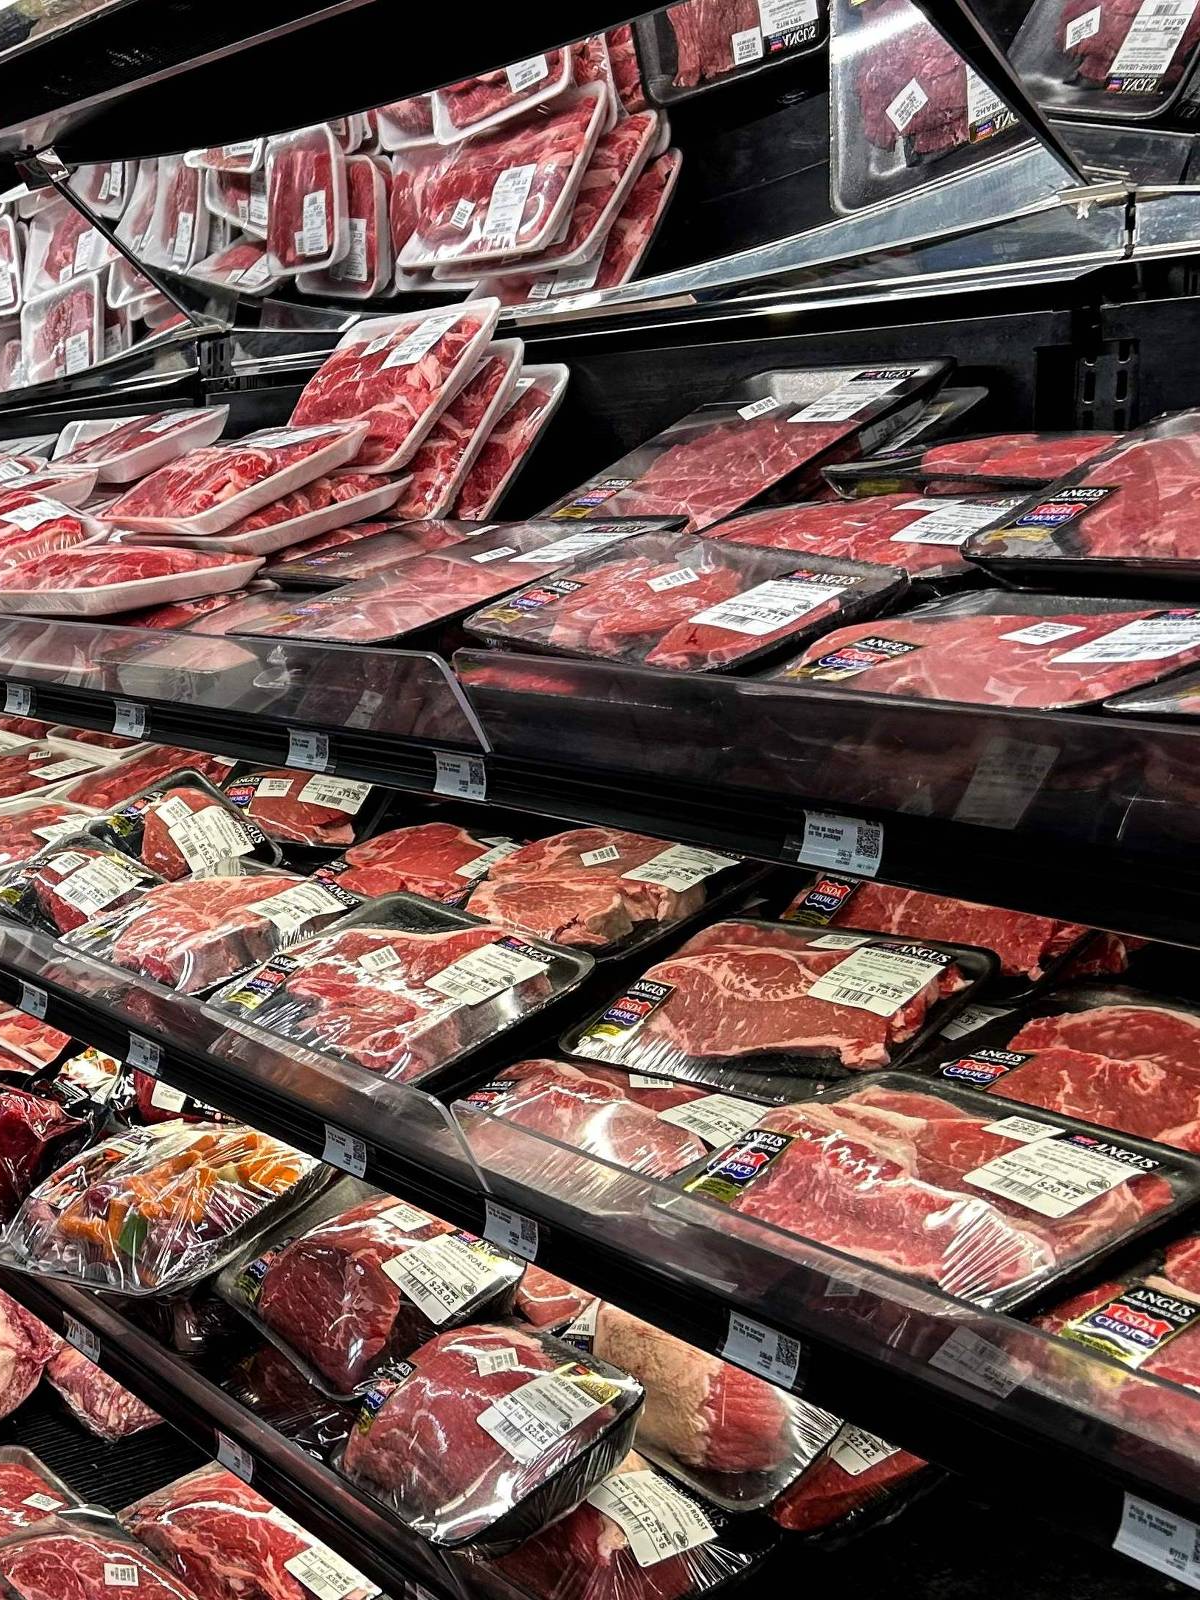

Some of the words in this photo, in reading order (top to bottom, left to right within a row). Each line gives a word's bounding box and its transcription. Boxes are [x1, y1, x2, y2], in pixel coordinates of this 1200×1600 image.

[1055, 489, 1109, 498] ANGUS
[326, 883, 360, 905] ANGUS
[810, 892, 840, 906] CHOICE
[819, 884, 842, 897] USDA
[898, 945, 951, 963] ANGUS
[868, 986, 902, 1000] $19.37
[608, 1008, 640, 1020] CHOICE
[620, 1000, 642, 1012] USDA
[976, 1049, 1026, 1062] ANGUS
[949, 1067, 994, 1079] CHOICE
[966, 1062, 996, 1074] USDA
[1092, 1142, 1160, 1170] ANGUS
[1036, 1180, 1079, 1200] $20.17
[446, 1240, 468, 1256] RUMP
[468, 1254, 492, 1274] ROAST
[428, 1280, 454, 1306] $25.02
[1129, 1290, 1196, 1317] ANGUS
[1095, 1315, 1156, 1346] CHOICE
[1114, 1308, 1158, 1334] USDA
[524, 1424, 548, 1445] $23.54
[690, 1509, 708, 1530] ROAST
